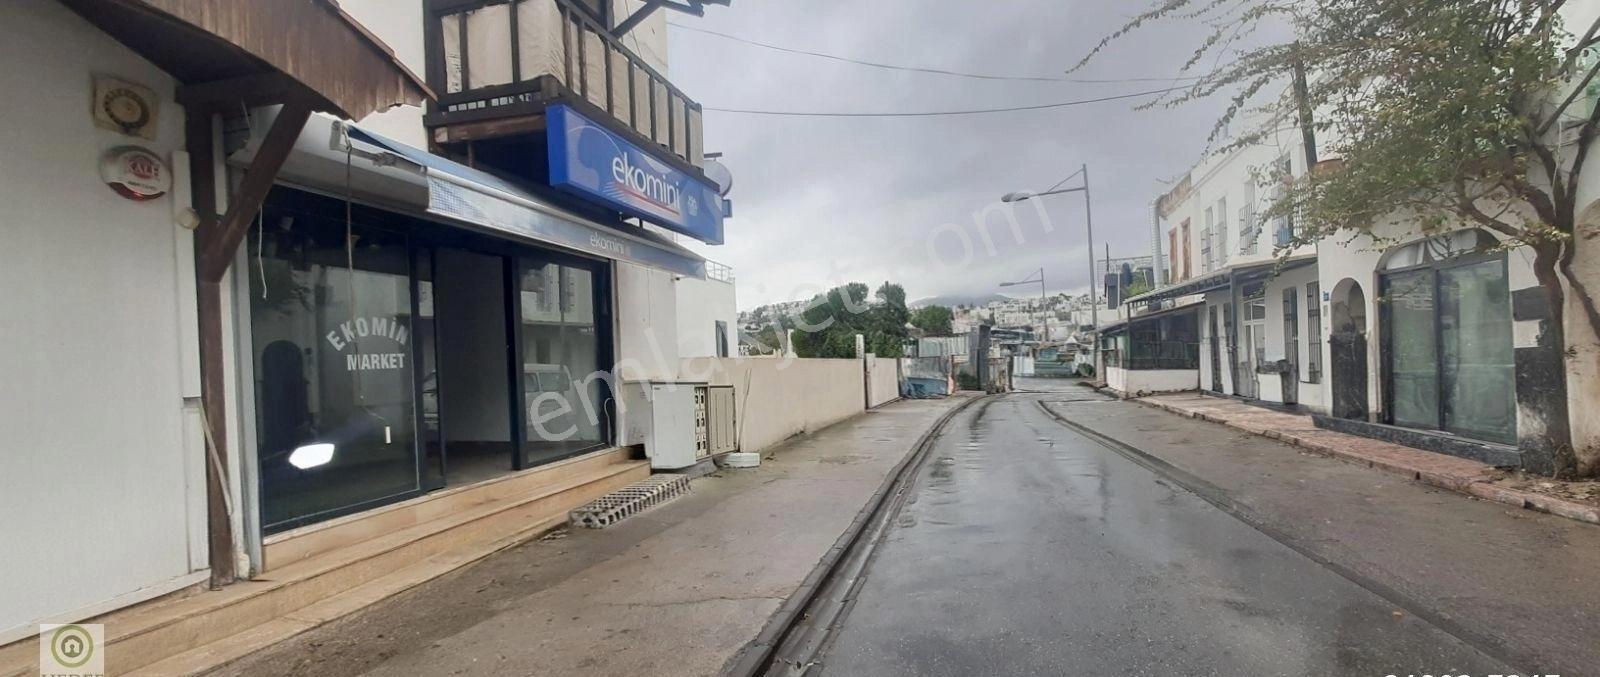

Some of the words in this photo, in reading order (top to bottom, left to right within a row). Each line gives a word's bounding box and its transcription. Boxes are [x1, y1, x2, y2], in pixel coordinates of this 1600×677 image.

[612, 152, 681, 209] ekomini
[590, 232, 625, 253] ekomini
[346, 353, 405, 371] MARKET
